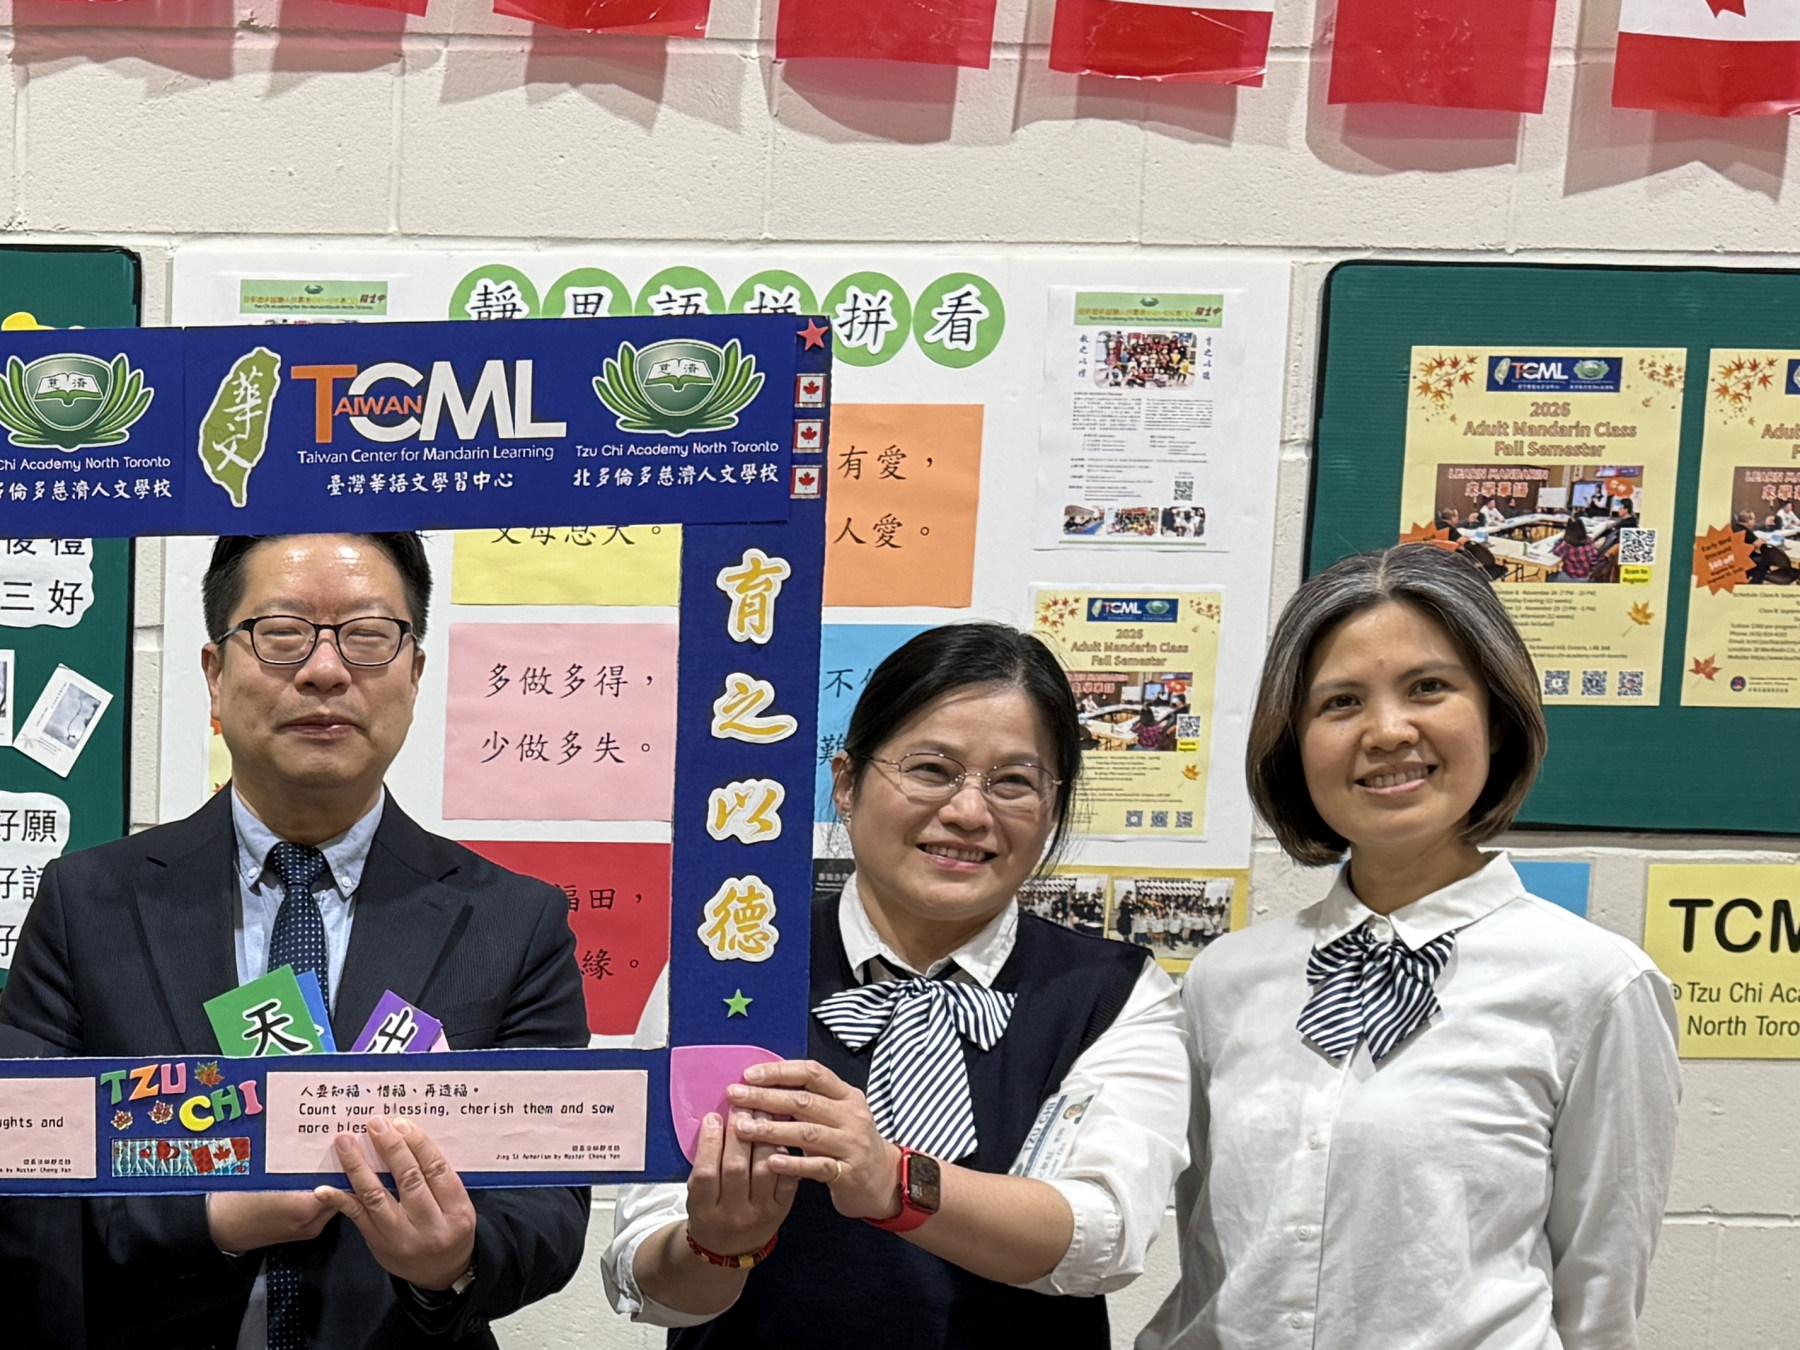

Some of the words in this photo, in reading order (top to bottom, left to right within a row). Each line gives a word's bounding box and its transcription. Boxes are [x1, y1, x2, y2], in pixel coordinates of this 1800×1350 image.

[1463, 420, 1510, 436] Adult
[1512, 421, 1591, 438] Mandarin
[1594, 422, 1637, 438] Class
[297, 451, 348, 464] Taiwan
[351, 449, 398, 462] Center
[401, 448, 419, 461] for
[423, 446, 489, 461] Mandarin
[493, 445, 554, 461] Learning
[576, 445, 597, 457] Tzu
[601, 444, 623, 456] Chi
[627, 444, 688, 457] Academy
[693, 442, 727, 454] North
[731, 441, 779, 453] Toronto
[1494, 441, 1524, 456] Fall
[1527, 442, 1606, 458] Semester
[20, 458, 81, 472] Academy
[86, 457, 119, 469] North
[123, 456, 171, 468] Toronto
[327, 471, 513, 496] 臺灣華語文學習中心
[573, 463, 779, 487] 北多倫多慈濟人文學校
[486, 663, 653, 698] 多做多得，
[481, 730, 650, 765] 少做多失。
[706, 559, 788, 953] 育之以德
[1687, 982, 1720, 1003] Tzu
[1730, 982, 1763, 1003] Chi
[243, 1001, 309, 1056] 天
[1687, 1016, 1746, 1036] North
[100, 1062, 186, 1105] TZU
[179, 1080, 263, 1132] CHI
[299, 1103, 336, 1115] Count
[345, 1106, 374, 1116] your
[384, 1102, 449, 1117] blessing,
[460, 1102, 514, 1115] cherish
[523, 1102, 553, 1114] them
[561, 1102, 583, 1114] and
[592, 1104, 614, 1114] sow
[41, 1116, 63, 1128] and
[298, 1124, 329, 1134] more
